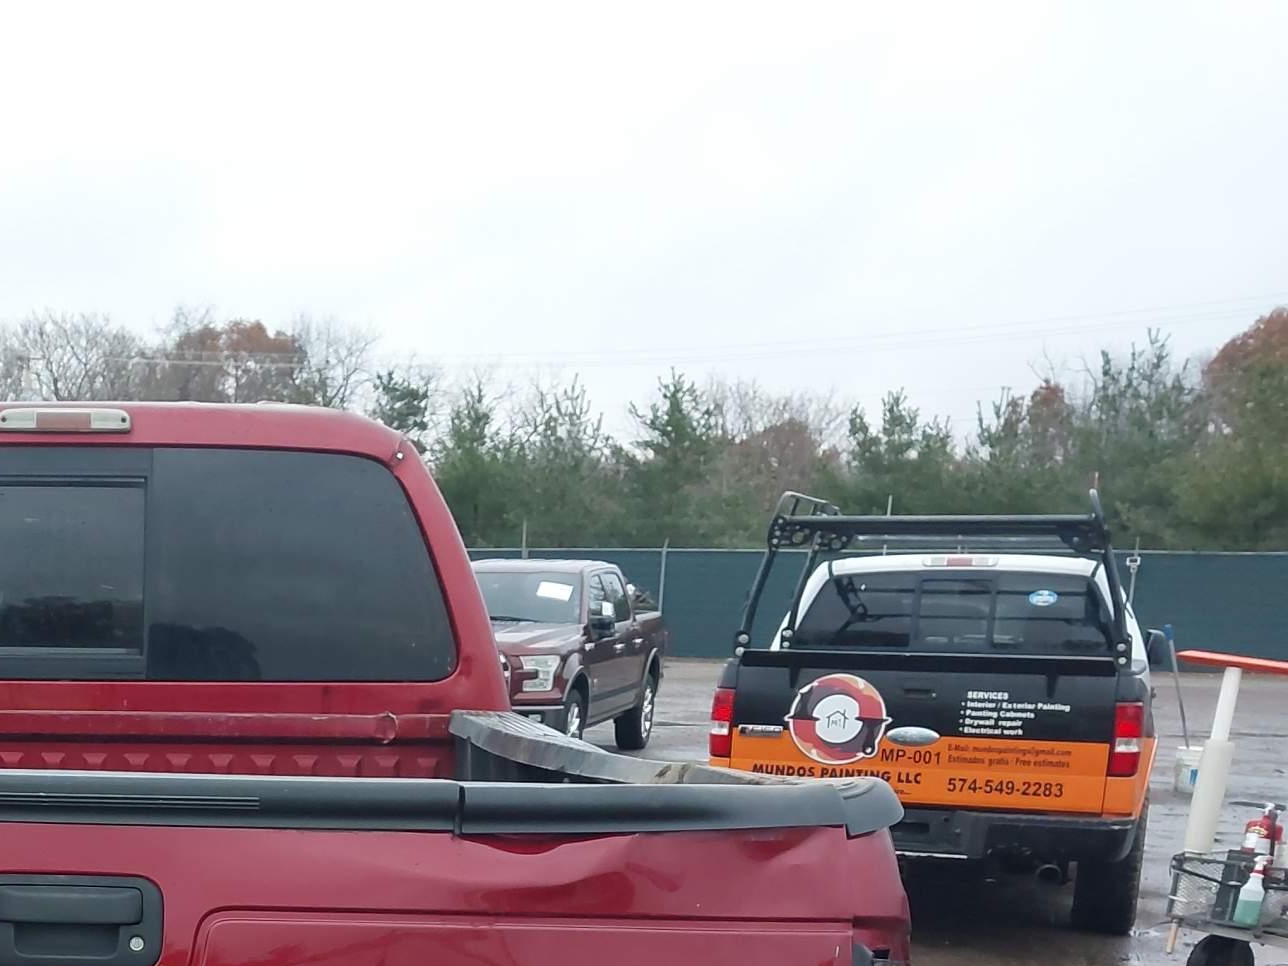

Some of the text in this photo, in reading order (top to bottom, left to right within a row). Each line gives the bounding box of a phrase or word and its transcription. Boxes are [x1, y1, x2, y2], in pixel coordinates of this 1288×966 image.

[967, 691, 1009, 700] SERVICES
[966, 701, 996, 709] Interior
[1002, 702, 1036, 710] Exterior
[1037, 703, 1070, 712] Painting
[965, 709, 998, 718] Painting
[964, 718, 1023, 727] Drywall repair
[964, 727, 1023, 736] Electrical work
[880, 749, 942, 766] MP-001
[1015, 757, 1031, 767] Free
[1033, 759, 1070, 769] estimates
[752, 763, 923, 786] MUNDOS PAINTING LLC
[947, 778, 1065, 798] 574-549-2283
